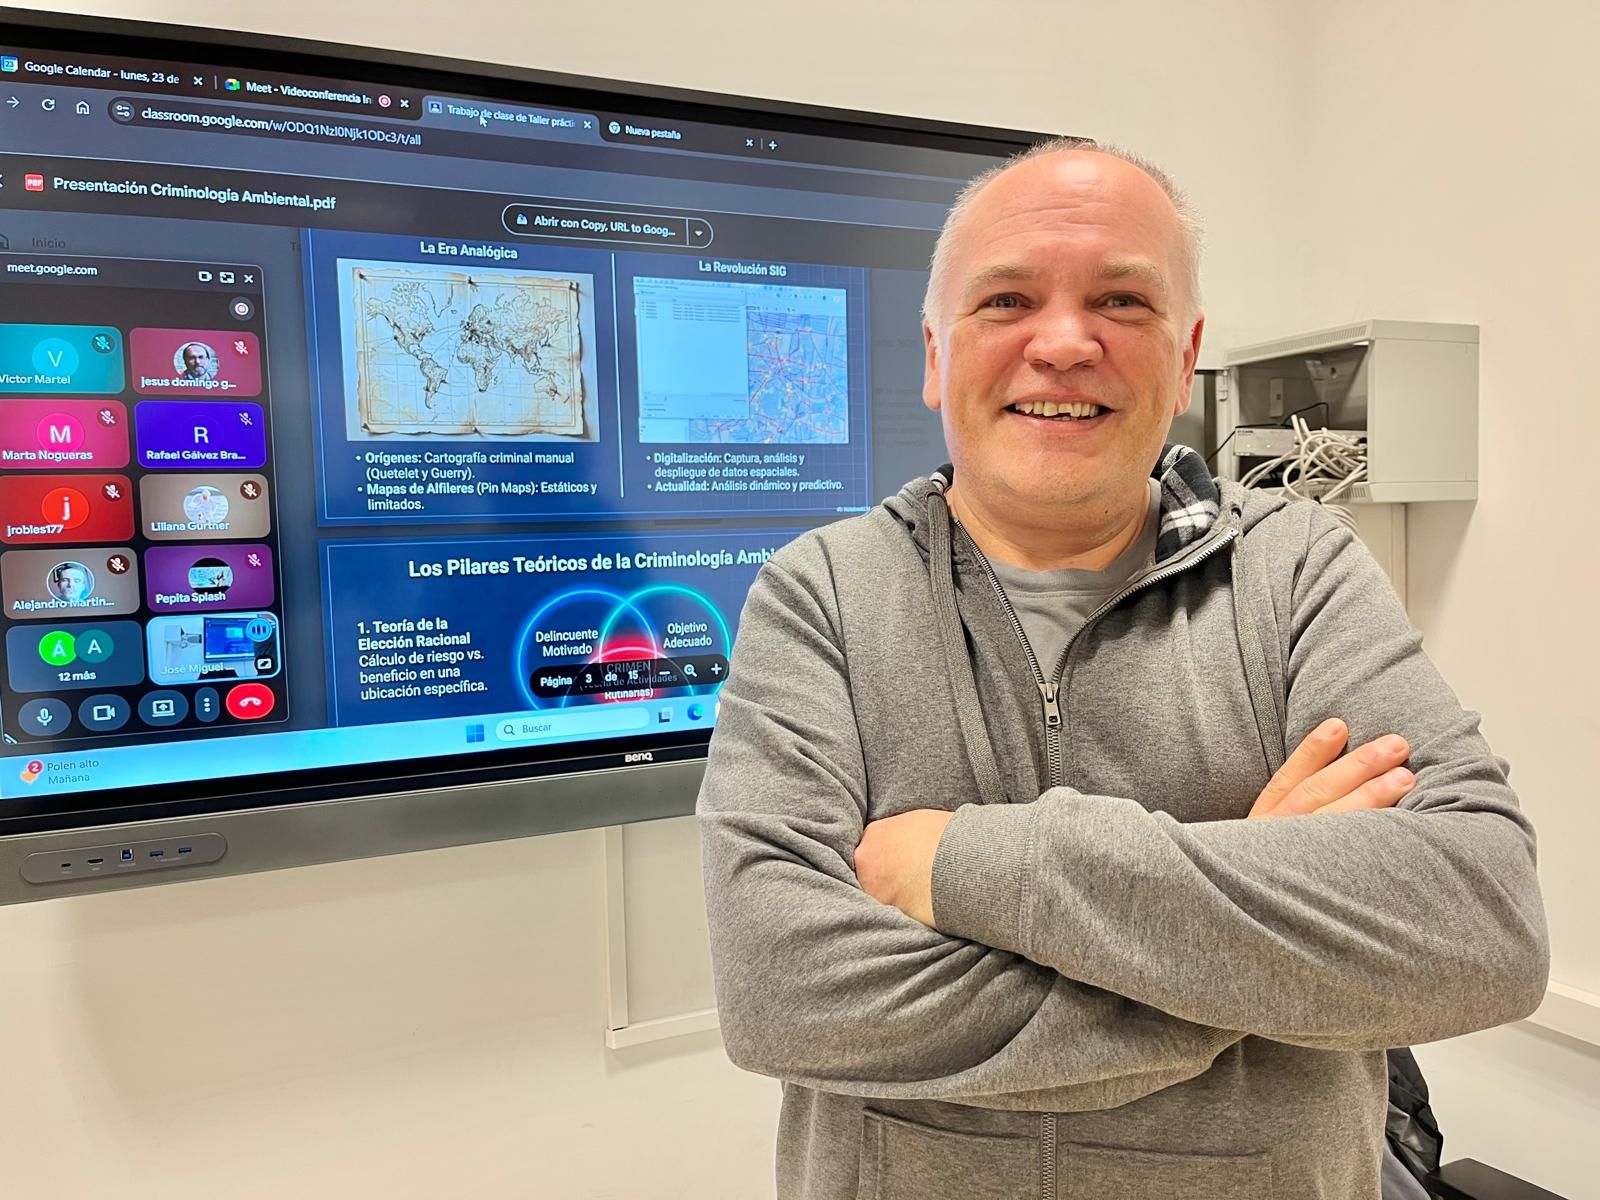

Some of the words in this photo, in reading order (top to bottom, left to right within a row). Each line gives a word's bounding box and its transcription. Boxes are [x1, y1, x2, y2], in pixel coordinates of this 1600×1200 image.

[25, 61, 63, 74] Google
[65, 65, 111, 78] Calendar
[120, 70, 150, 83] lunes,
[152, 73, 164, 83] 23
[166, 74, 180, 84] de
[246, 82, 272, 94] Meet
[280, 85, 361, 104] Videoconferencia
[448, 104, 479, 118] Trabajo
[480, 109, 492, 118] de
[494, 110, 514, 121] clase
[516, 113, 527, 122] de
[528, 114, 549, 125] Taller
[625, 125, 650, 136] Nueva
[651, 129, 681, 140] pestaña
[27, 178, 43, 188] PDF
[54, 177, 148, 195] Presentación
[242, 190, 337, 211] Ambiental.pdf
[534, 215, 559, 229] Abrir
[561, 219, 579, 230] con
[580, 219, 608, 233] Copy,
[610, 221, 630, 233] URL
[631, 223, 641, 234] to
[32, 237, 66, 249] Inicio
[420, 241, 437, 254] La
[438, 242, 458, 255] Era
[460, 245, 518, 261] Analógica
[7, 262, 98, 277] meet.google.com
[699, 260, 711, 271] La
[713, 261, 768, 276] Revolución
[769, 265, 787, 277] SIG
[47, 350, 64, 368] V
[34, 374, 71, 385] Martel
[140, 376, 170, 388] jesus
[171, 378, 219, 389] domingo
[50, 425, 71, 443] M
[194, 426, 209, 443] R
[2, 450, 36, 461] Marta
[38, 450, 94, 462] Nogueras
[146, 450, 180, 460] Rafael
[182, 450, 218, 460] Gálvez
[365, 452, 422, 466] Orígenes:
[424, 451, 487, 465] Cartografía
[489, 452, 533, 464] criminal
[535, 452, 574, 464] manual
[654, 452, 722, 466] Digitalización:
[724, 453, 762, 465] Captura,
[764, 453, 798, 464] análisis
[799, 456, 805, 465] y
[366, 467, 419, 481] (Quetelet
[421, 470, 429, 481] y
[431, 467, 475, 480] Guerry).
[655, 467, 706, 478] despliegue
[708, 467, 720, 477] de
[722, 467, 748, 477] datos
[750, 467, 800, 478] espaciales.
[367, 484, 407, 498] Mapas
[409, 483, 424, 494] de
[427, 483, 474, 494] Alfileres
[477, 482, 498, 496] (Pin
[501, 482, 539, 495] Maps):
[541, 481, 589, 493] Estáticos
[590, 484, 597, 494] y
[655, 480, 710, 491] Actualidad:
[711, 480, 747, 491] Análisis
[749, 480, 791, 490] dinámico
[792, 483, 798, 492] y
[799, 480, 844, 491] predictivo.
[62, 496, 70, 521] j
[368, 499, 424, 510] limitados.
[7, 524, 64, 536] jrobles177
[151, 522, 186, 532] Liliana
[409, 561, 442, 578] Los
[447, 558, 509, 576] Pilares
[512, 555, 588, 574] Teóricos
[591, 553, 612, 570] de
[616, 553, 631, 569] la
[634, 551, 733, 570] Criminología
[12, 600, 67, 611] Alejandro
[155, 593, 190, 605] Pepita
[191, 592, 226, 603] Splash
[357, 622, 370, 635] 1.
[373, 619, 414, 633] Teoría
[417, 618, 433, 630] de
[436, 617, 448, 629] la
[667, 622, 707, 635] Objetivo
[358, 636, 413, 650] Elección
[416, 632, 470, 647] Racional
[536, 629, 598, 642] Delincuente
[663, 635, 712, 648] Adecuado
[52, 641, 67, 658] Á
[87, 640, 102, 654] A
[543, 643, 592, 657] Motivado
[359, 653, 406, 667] Cálculo
[409, 651, 424, 663] de
[427, 651, 464, 665] riesgo
[467, 650, 484, 660] vs.
[607, 661, 650, 673] CRIMEN
[58, 672, 71, 682] 12
[72, 671, 97, 681] más
[360, 669, 417, 683] beneficio
[420, 670, 435, 679] en
[438, 667, 460, 678] una
[541, 676, 572, 688] Página
[586, 674, 592, 683] 3
[605, 672, 617, 681] de
[629, 670, 638, 679] 15
[361, 684, 420, 700] ubicación
[424, 681, 488, 696] específica.
[522, 724, 551, 733] Buscar
[32, 763, 39, 772] 2
[47, 760, 76, 772] Polen
[80, 759, 99, 769] alto
[48, 773, 90, 785] Mañana
